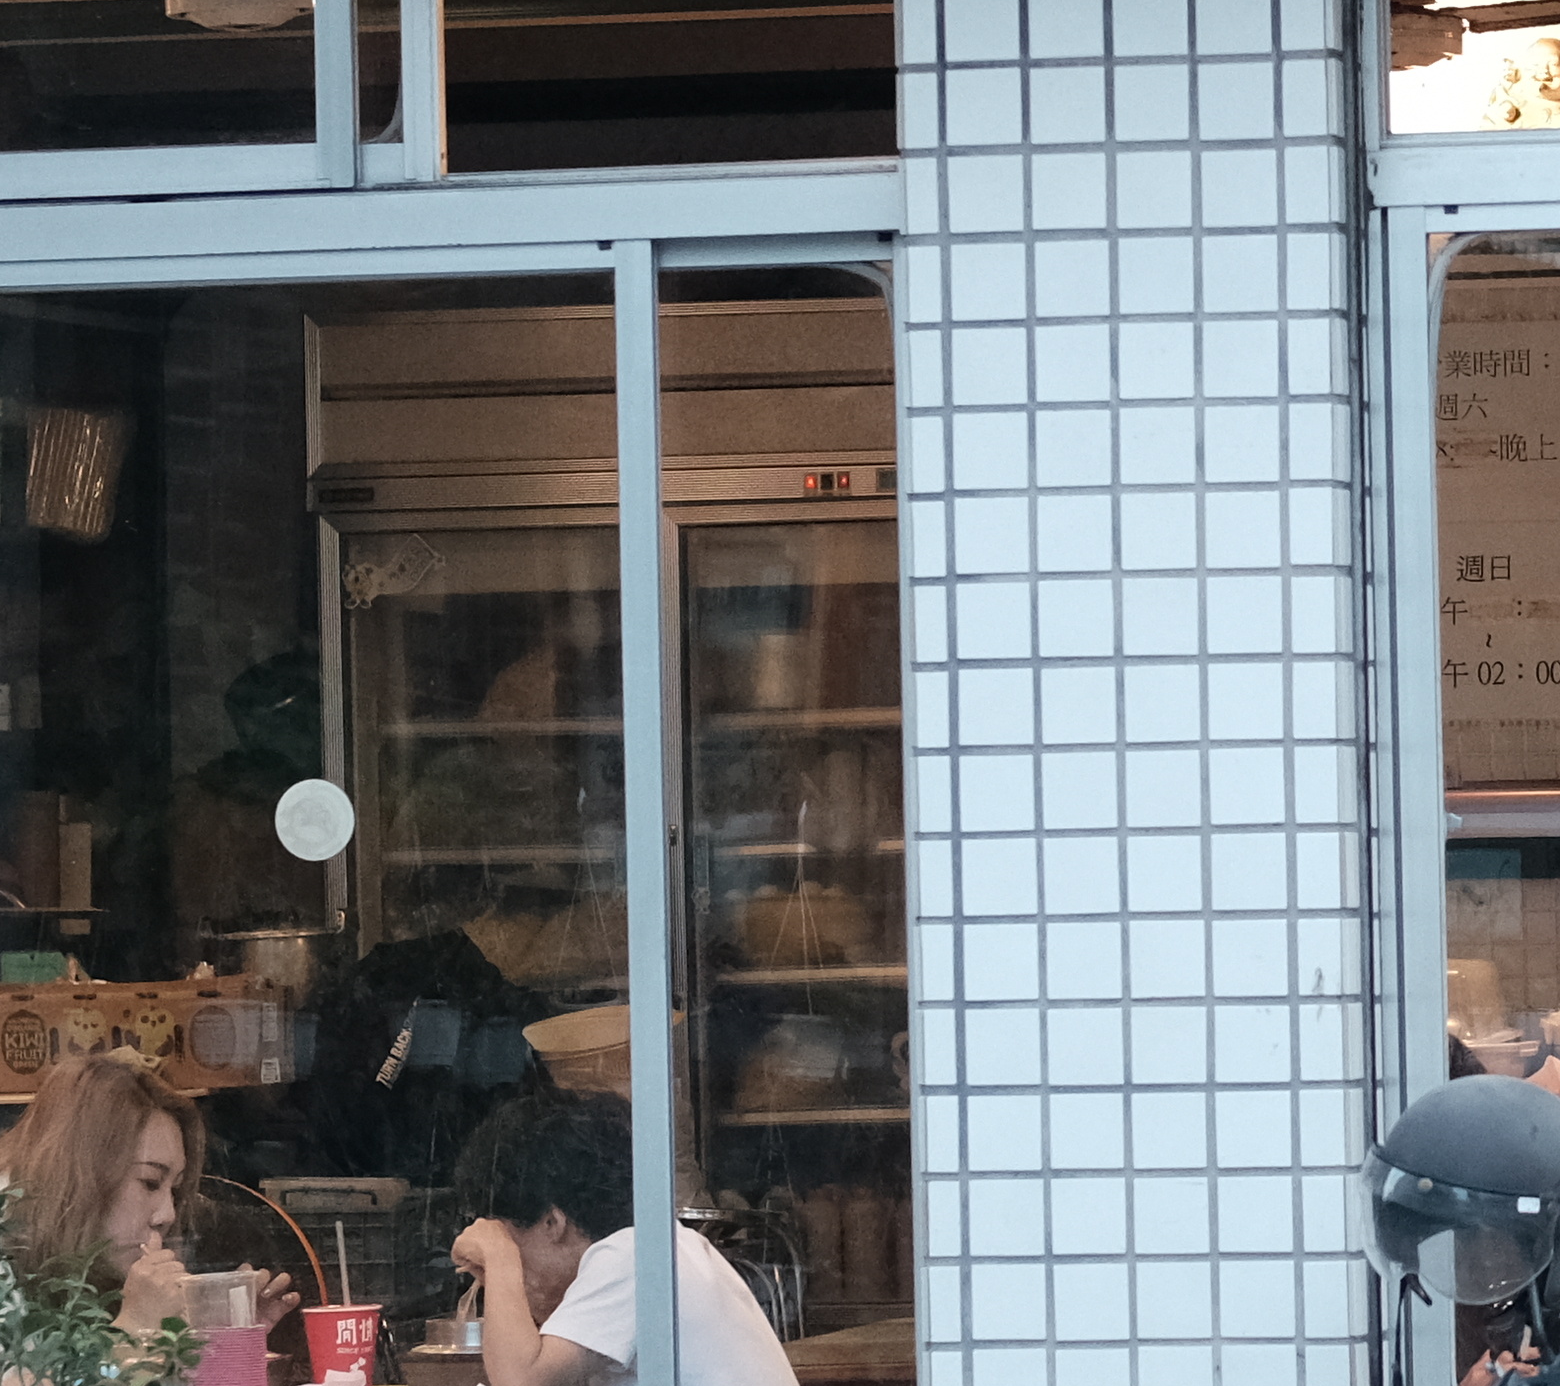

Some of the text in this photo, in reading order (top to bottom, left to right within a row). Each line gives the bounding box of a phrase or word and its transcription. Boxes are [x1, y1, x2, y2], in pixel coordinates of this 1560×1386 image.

[1437, 348, 1552, 380] 業時間：
[1456, 554, 1512, 583] 週日
[4, 1032, 45, 1049] KIWI
[5, 1048, 45, 1061] FRUIT
